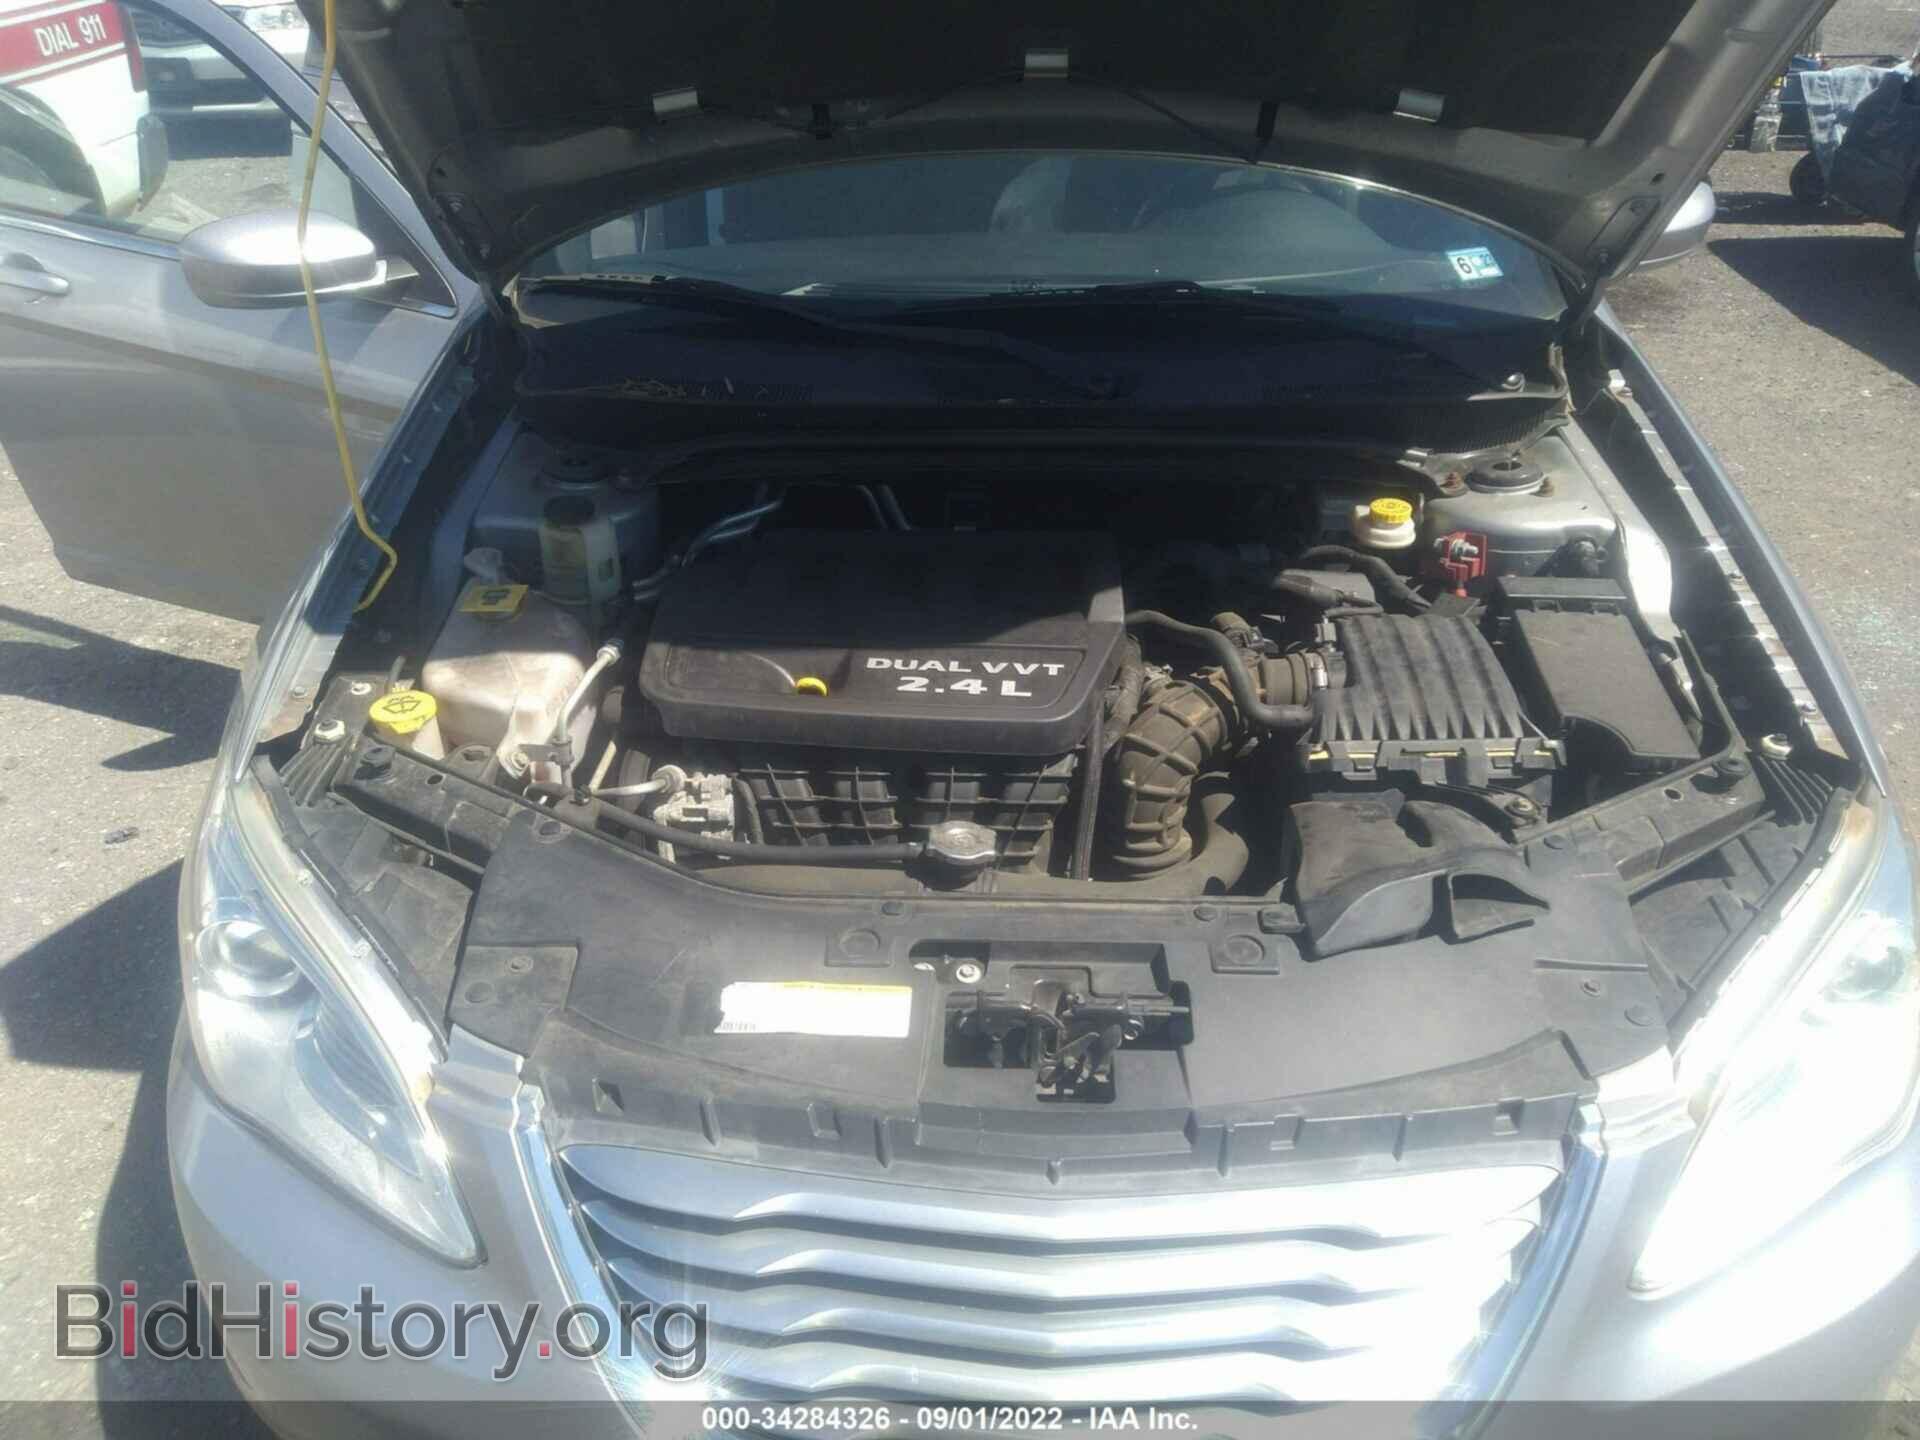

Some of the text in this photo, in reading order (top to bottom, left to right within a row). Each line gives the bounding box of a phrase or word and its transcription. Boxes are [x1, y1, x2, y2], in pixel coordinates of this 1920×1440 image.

[34, 13, 107, 56] DIAL 911
[1456, 256, 1472, 274] 6
[866, 657, 1065, 676] DUAL VVT
[896, 676, 988, 694] 2.4
